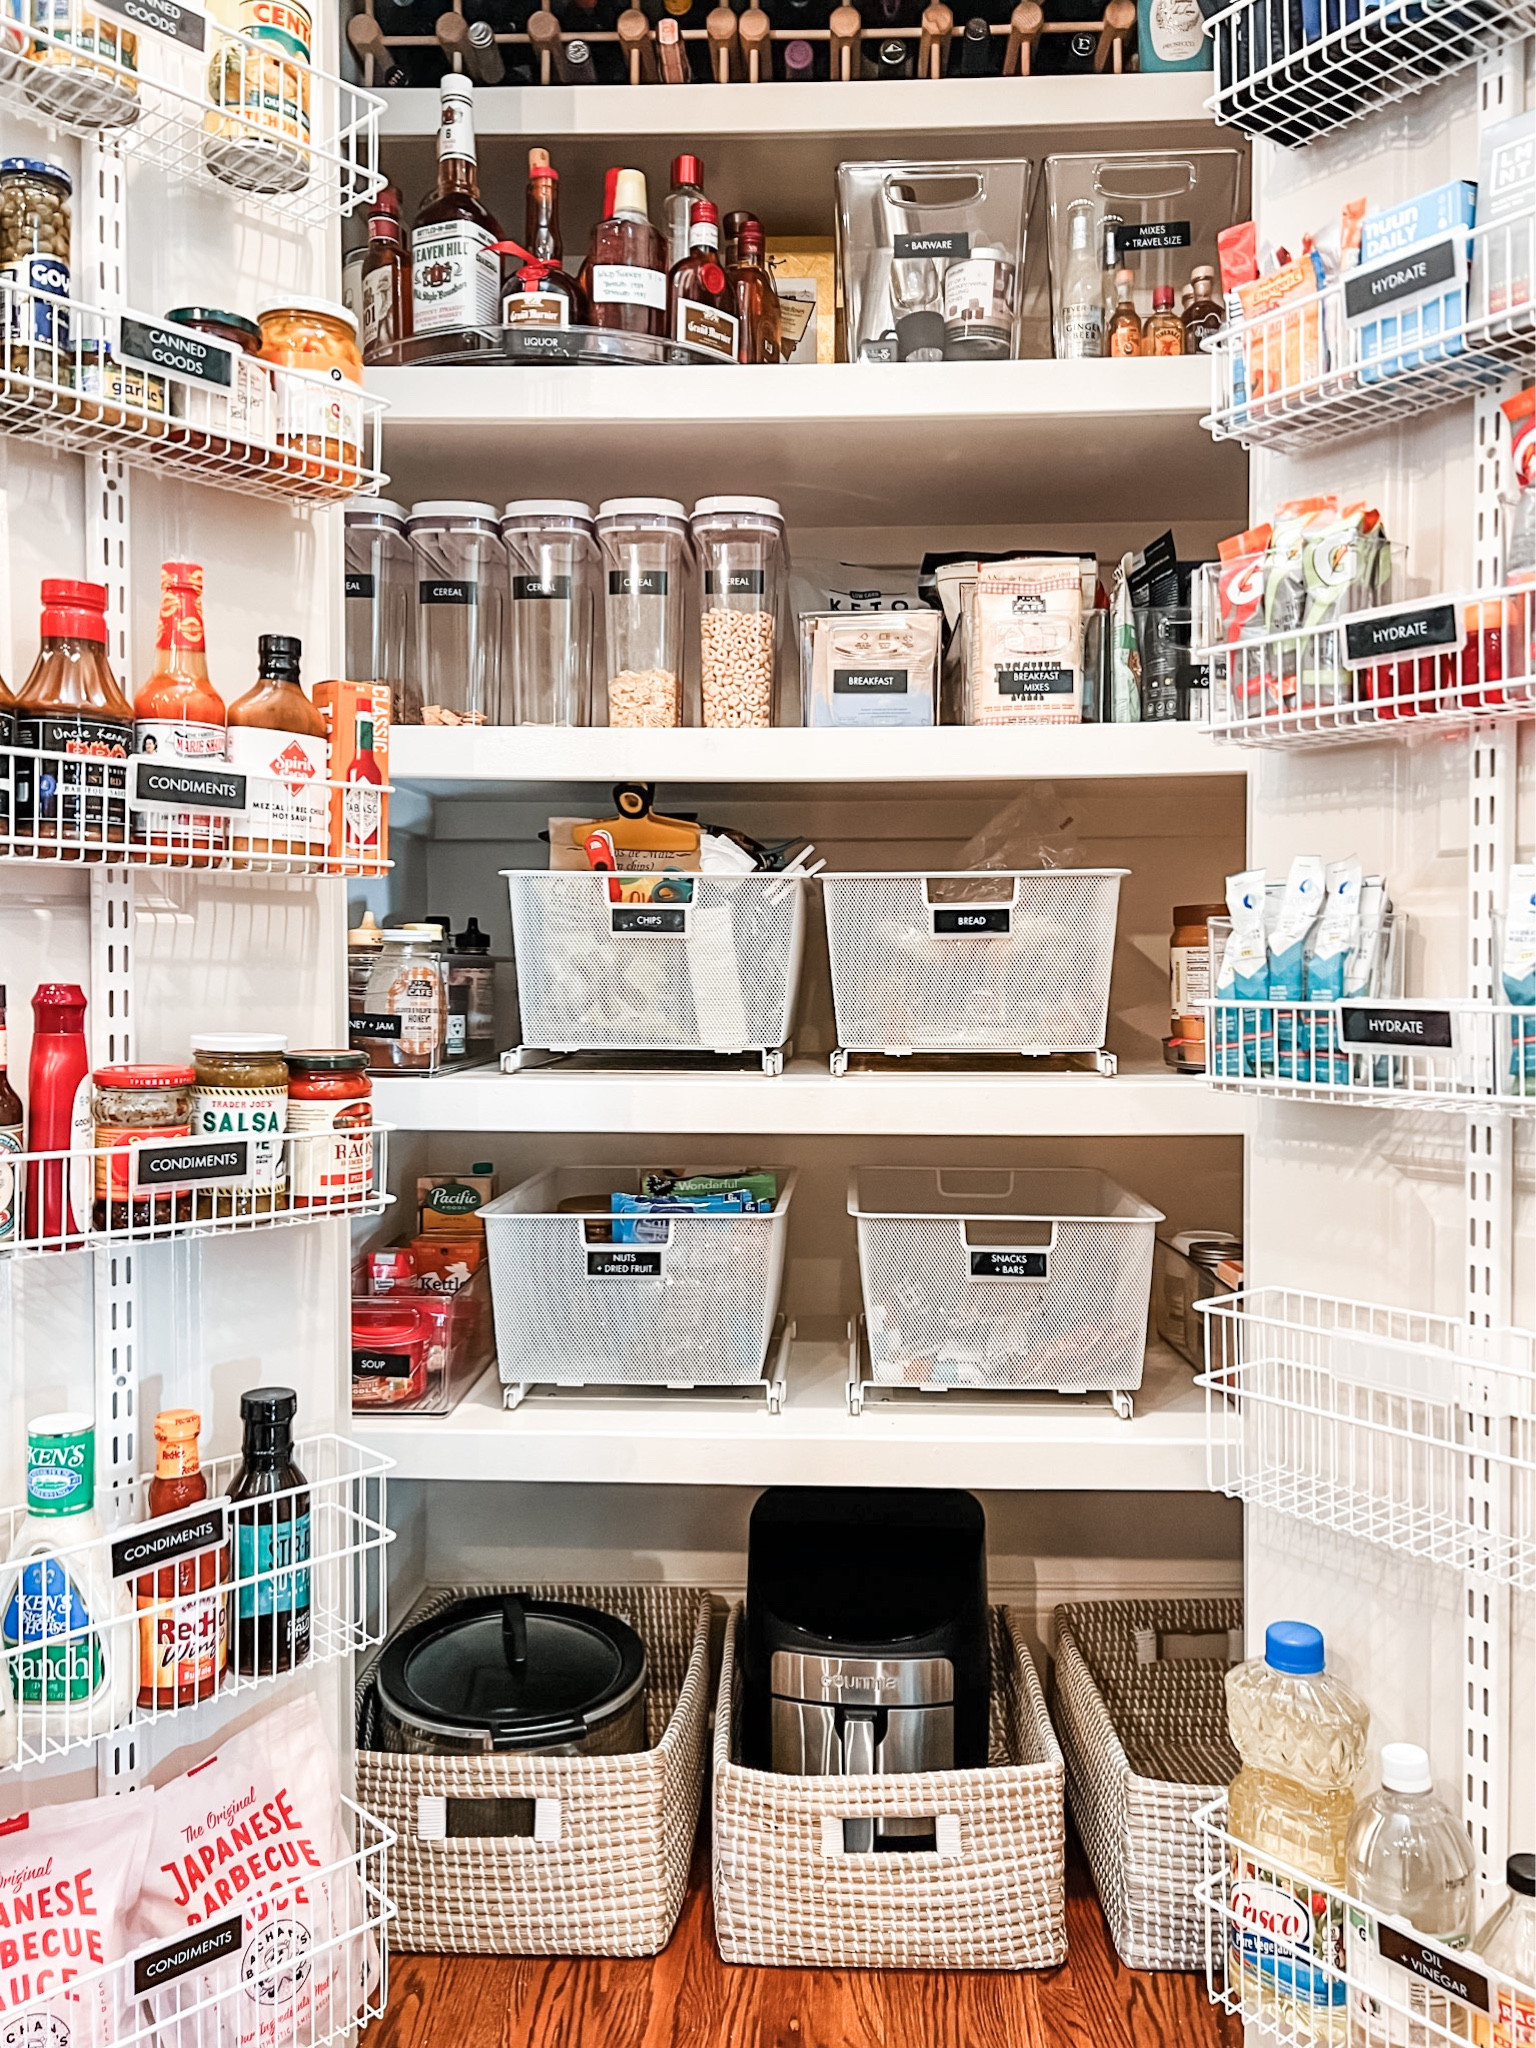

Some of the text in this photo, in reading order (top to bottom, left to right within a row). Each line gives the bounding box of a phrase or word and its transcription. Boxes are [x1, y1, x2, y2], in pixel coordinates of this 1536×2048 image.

[125, 2, 177, 35] GOODS
[253, 3, 310, 43] CENT
[1500, 142, 1534, 168] LM
[1499, 160, 1532, 186] NT
[1139, 225, 1166, 235] MIXES
[1364, 206, 1419, 242] nuun
[911, 240, 953, 251] BARWARE
[1132, 237, 1161, 248] TRAVEL
[1163, 235, 1182, 245] SIZE
[1366, 223, 1418, 259] DAILY
[412, 243, 444, 263] EAVEN
[1371, 262, 1428, 296] HYDRATE
[523, 337, 559, 348] LIQUOR
[1073, 331, 1097, 340] BEER
[149, 330, 207, 359] CANNED
[151, 348, 204, 376] GOODS
[526, 582, 557, 593] CERAL
[623, 577, 654, 588] CEAL
[432, 587, 463, 598] CEREAL
[1372, 620, 1430, 644] HYDRATE
[848, 676, 894, 686] BREAKFAST
[1013, 671, 1060, 681] BREAKFAST
[1023, 682, 1051, 692] MIXES
[371, 685, 389, 754] CLASSIC
[52, 726, 92, 740] Uncle
[176, 739, 205, 753] MARIE
[275, 755, 312, 775] Spirit
[148, 775, 237, 798] CONDIMENTS
[272, 812, 289, 821] HOT
[636, 915, 663, 925] CHIPS
[957, 915, 987, 926] BREAD
[407, 989, 433, 997] CAFE
[375, 1022, 395, 1031] JAM
[407, 1014, 430, 1023] HONEY
[1368, 1019, 1424, 1035] HYDRATE
[211, 1099, 273, 1110] TRADER JOE'S
[202, 1111, 280, 1133] SALSA
[150, 1152, 239, 1173] CONDIMENTS
[678, 1179, 738, 1191] Wonderful
[430, 1187, 478, 1206] Pacific
[612, 1253, 637, 1263] NUTS
[990, 1254, 1028, 1265] SNACKS
[604, 1264, 629, 1273] DRIED
[630, 1264, 654, 1273] FRUIT
[1002, 1264, 1025, 1275] BARS
[420, 1277, 461, 1291] Kettl
[361, 1359, 386, 1370] SOUP
[27, 1443, 86, 1468] KEN'S
[123, 1521, 215, 1562] CONDIMENTS
[14, 1594, 74, 1615] KEN'S
[7, 1646, 91, 1681] Ranch
[181, 1785, 257, 1844] The Original
[160, 1787, 304, 1907] JAPANESE
[1231, 1892, 1300, 1938] Crisco
[145, 1930, 233, 1978] CONDIMENTS
[1421, 1949, 1444, 1970] OIL
[1410, 1957, 1469, 1998] VINEGAR
